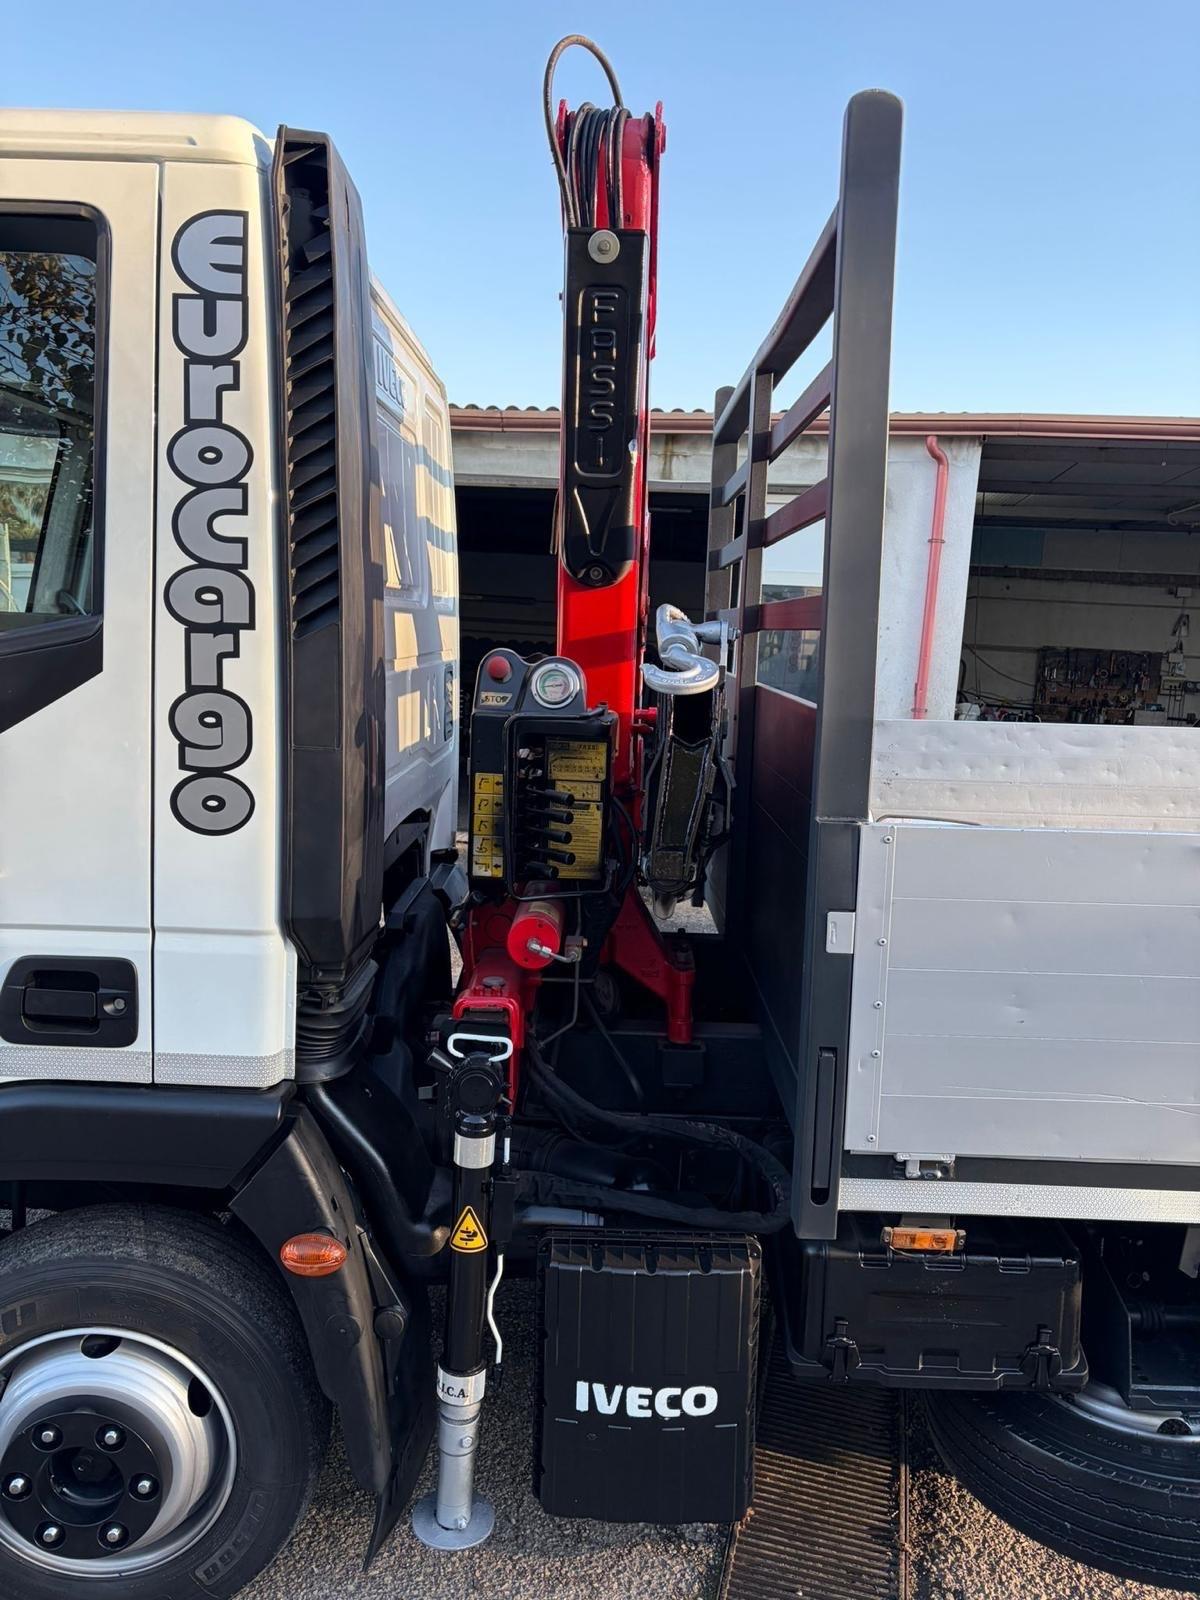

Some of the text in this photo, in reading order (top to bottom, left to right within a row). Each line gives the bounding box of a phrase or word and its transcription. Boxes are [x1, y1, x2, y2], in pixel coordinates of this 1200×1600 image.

[587, 292, 618, 467] FASSI
[163, 209, 256, 836] Eurocargo
[575, 1380, 719, 1418] IVECO
